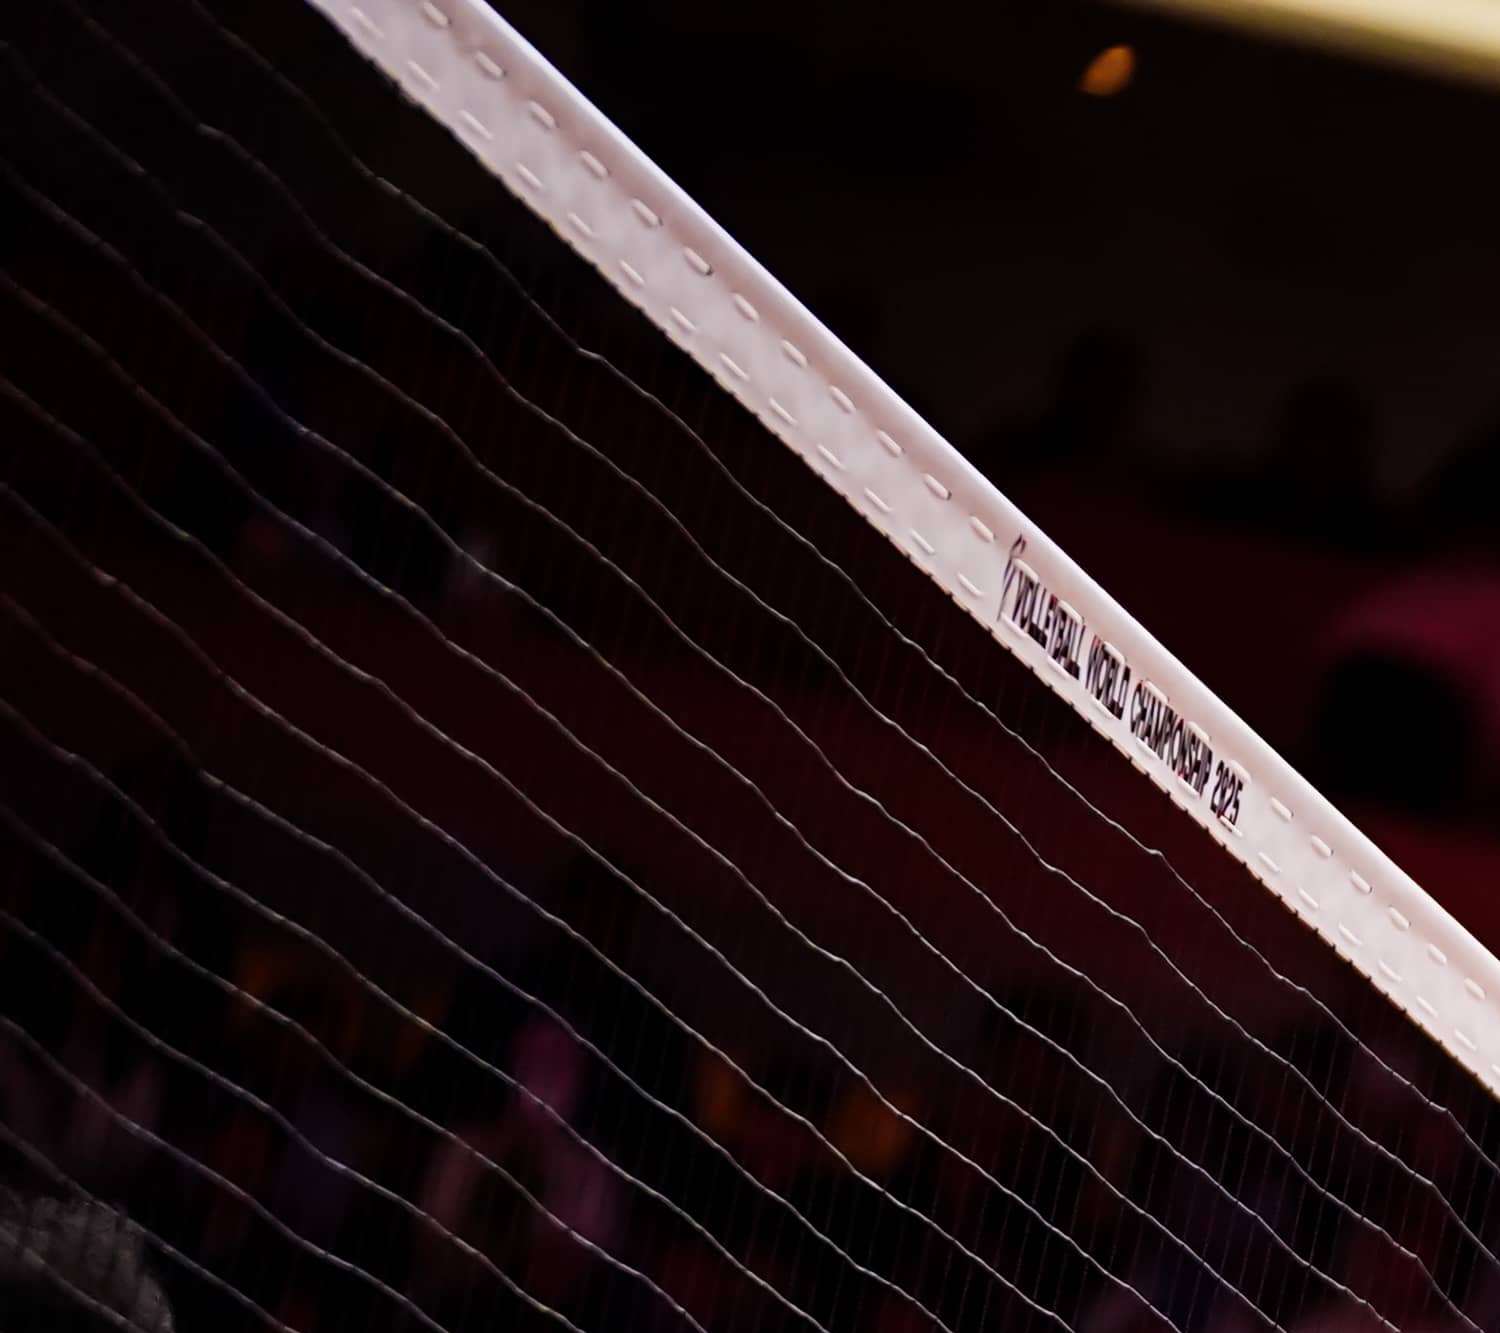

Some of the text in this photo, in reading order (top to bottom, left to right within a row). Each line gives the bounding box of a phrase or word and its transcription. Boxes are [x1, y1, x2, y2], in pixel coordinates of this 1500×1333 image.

[1012, 574, 1086, 681] VOLLEYBALL
[1085, 635, 1132, 720] WORLD
[1129, 680, 1214, 798] CHAMPIONSHIP
